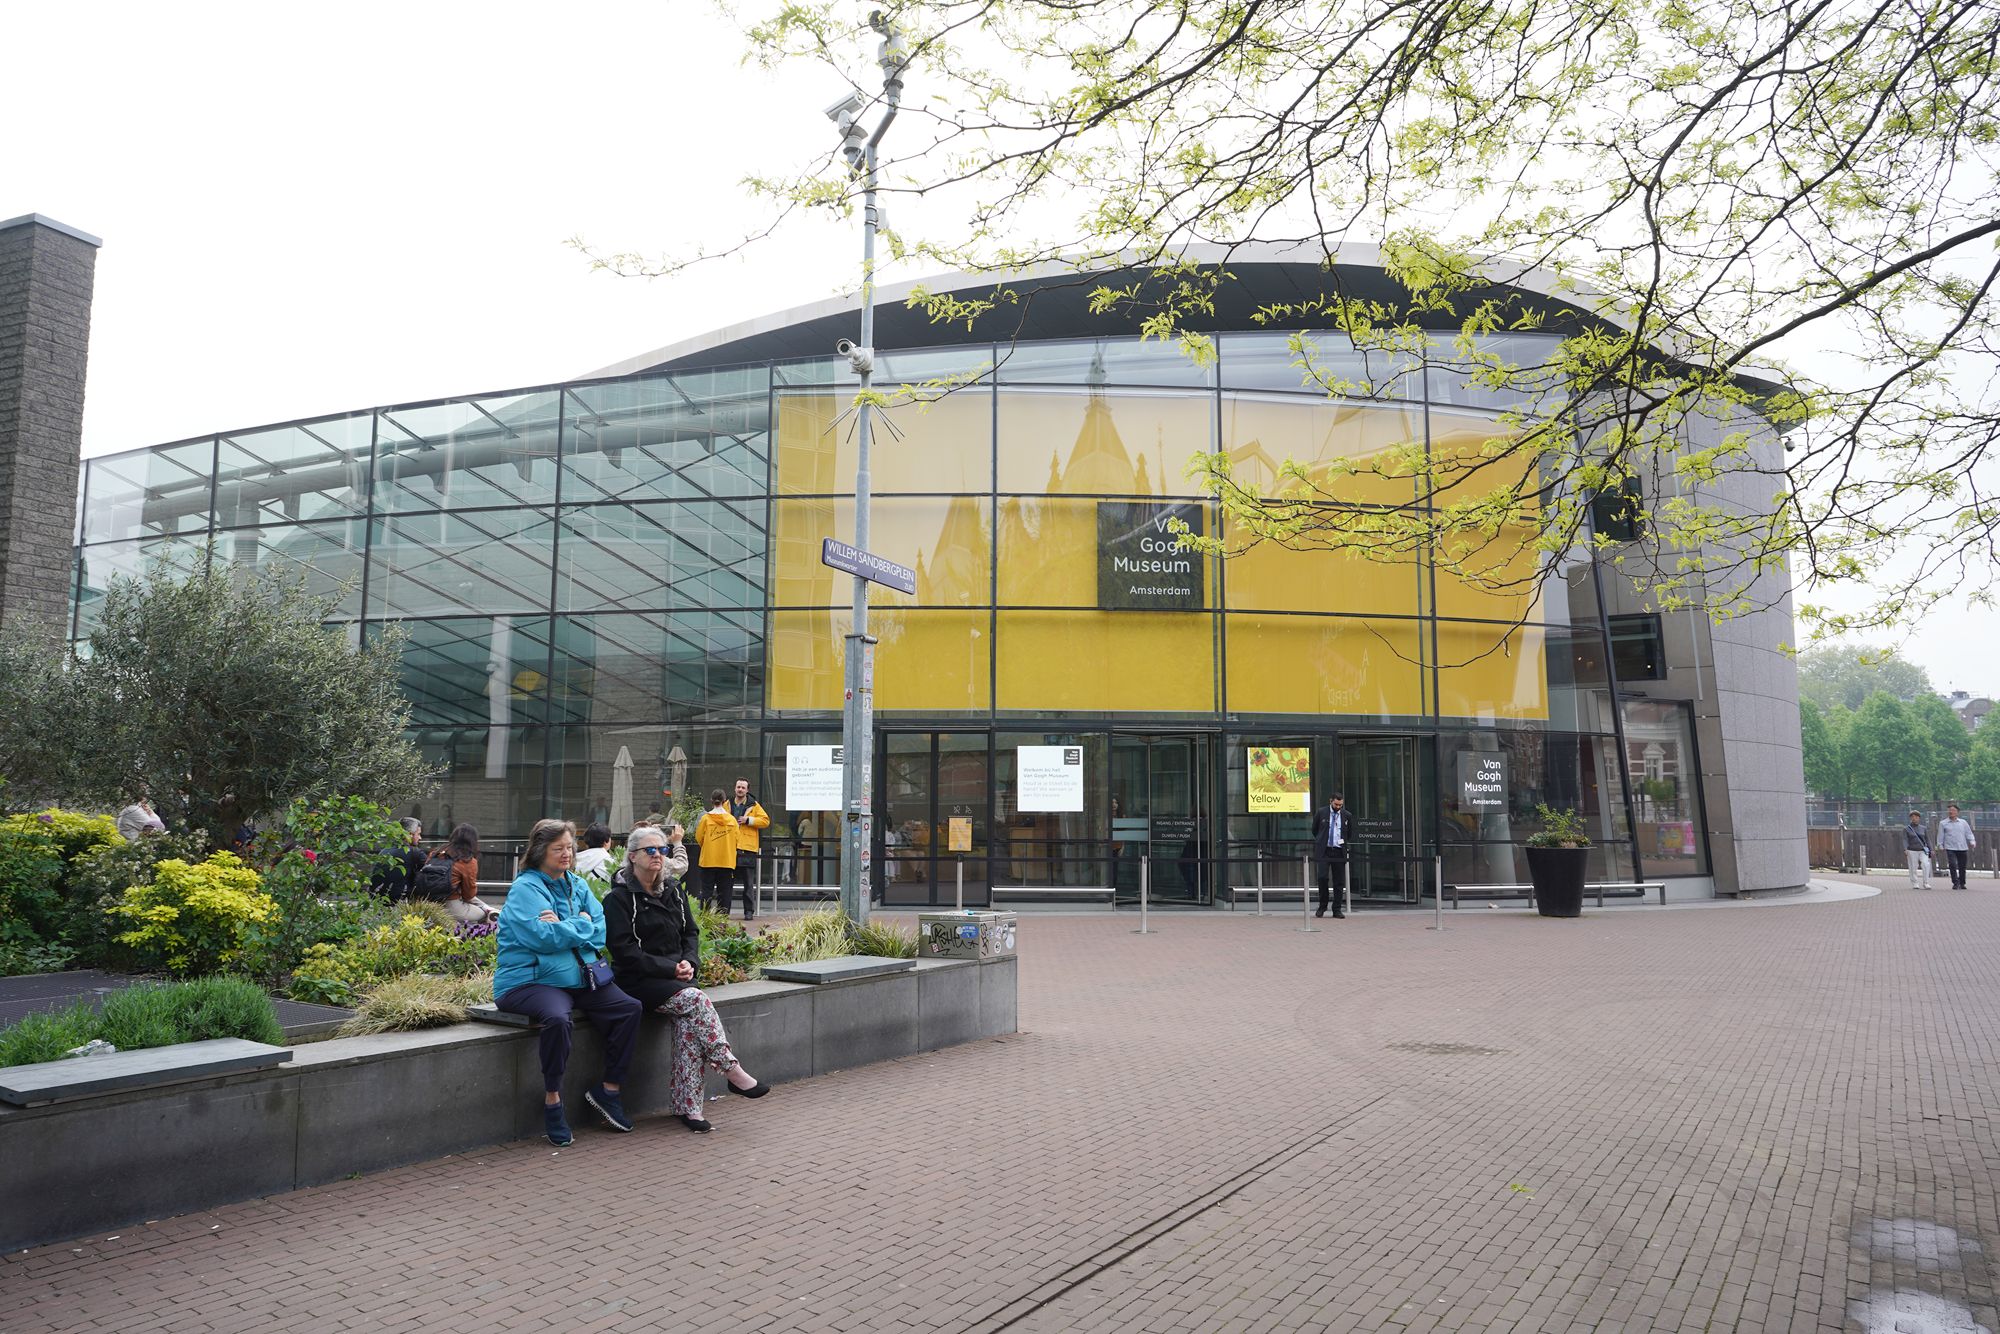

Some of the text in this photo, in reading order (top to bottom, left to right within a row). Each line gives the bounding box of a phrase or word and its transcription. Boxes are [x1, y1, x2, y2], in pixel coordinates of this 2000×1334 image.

[1154, 518, 1190, 533] Vn
[828, 540, 914, 582] WILLEM SANDBERGPLEIN
[1114, 556, 1190, 573] Museum
[1130, 586, 1190, 595] Amsterdam
[1483, 760, 1501, 770] Van
[1476, 771, 1501, 782] Gogh
[1465, 782, 1502, 792] Museum
[1250, 794, 1281, 803] Yellow
